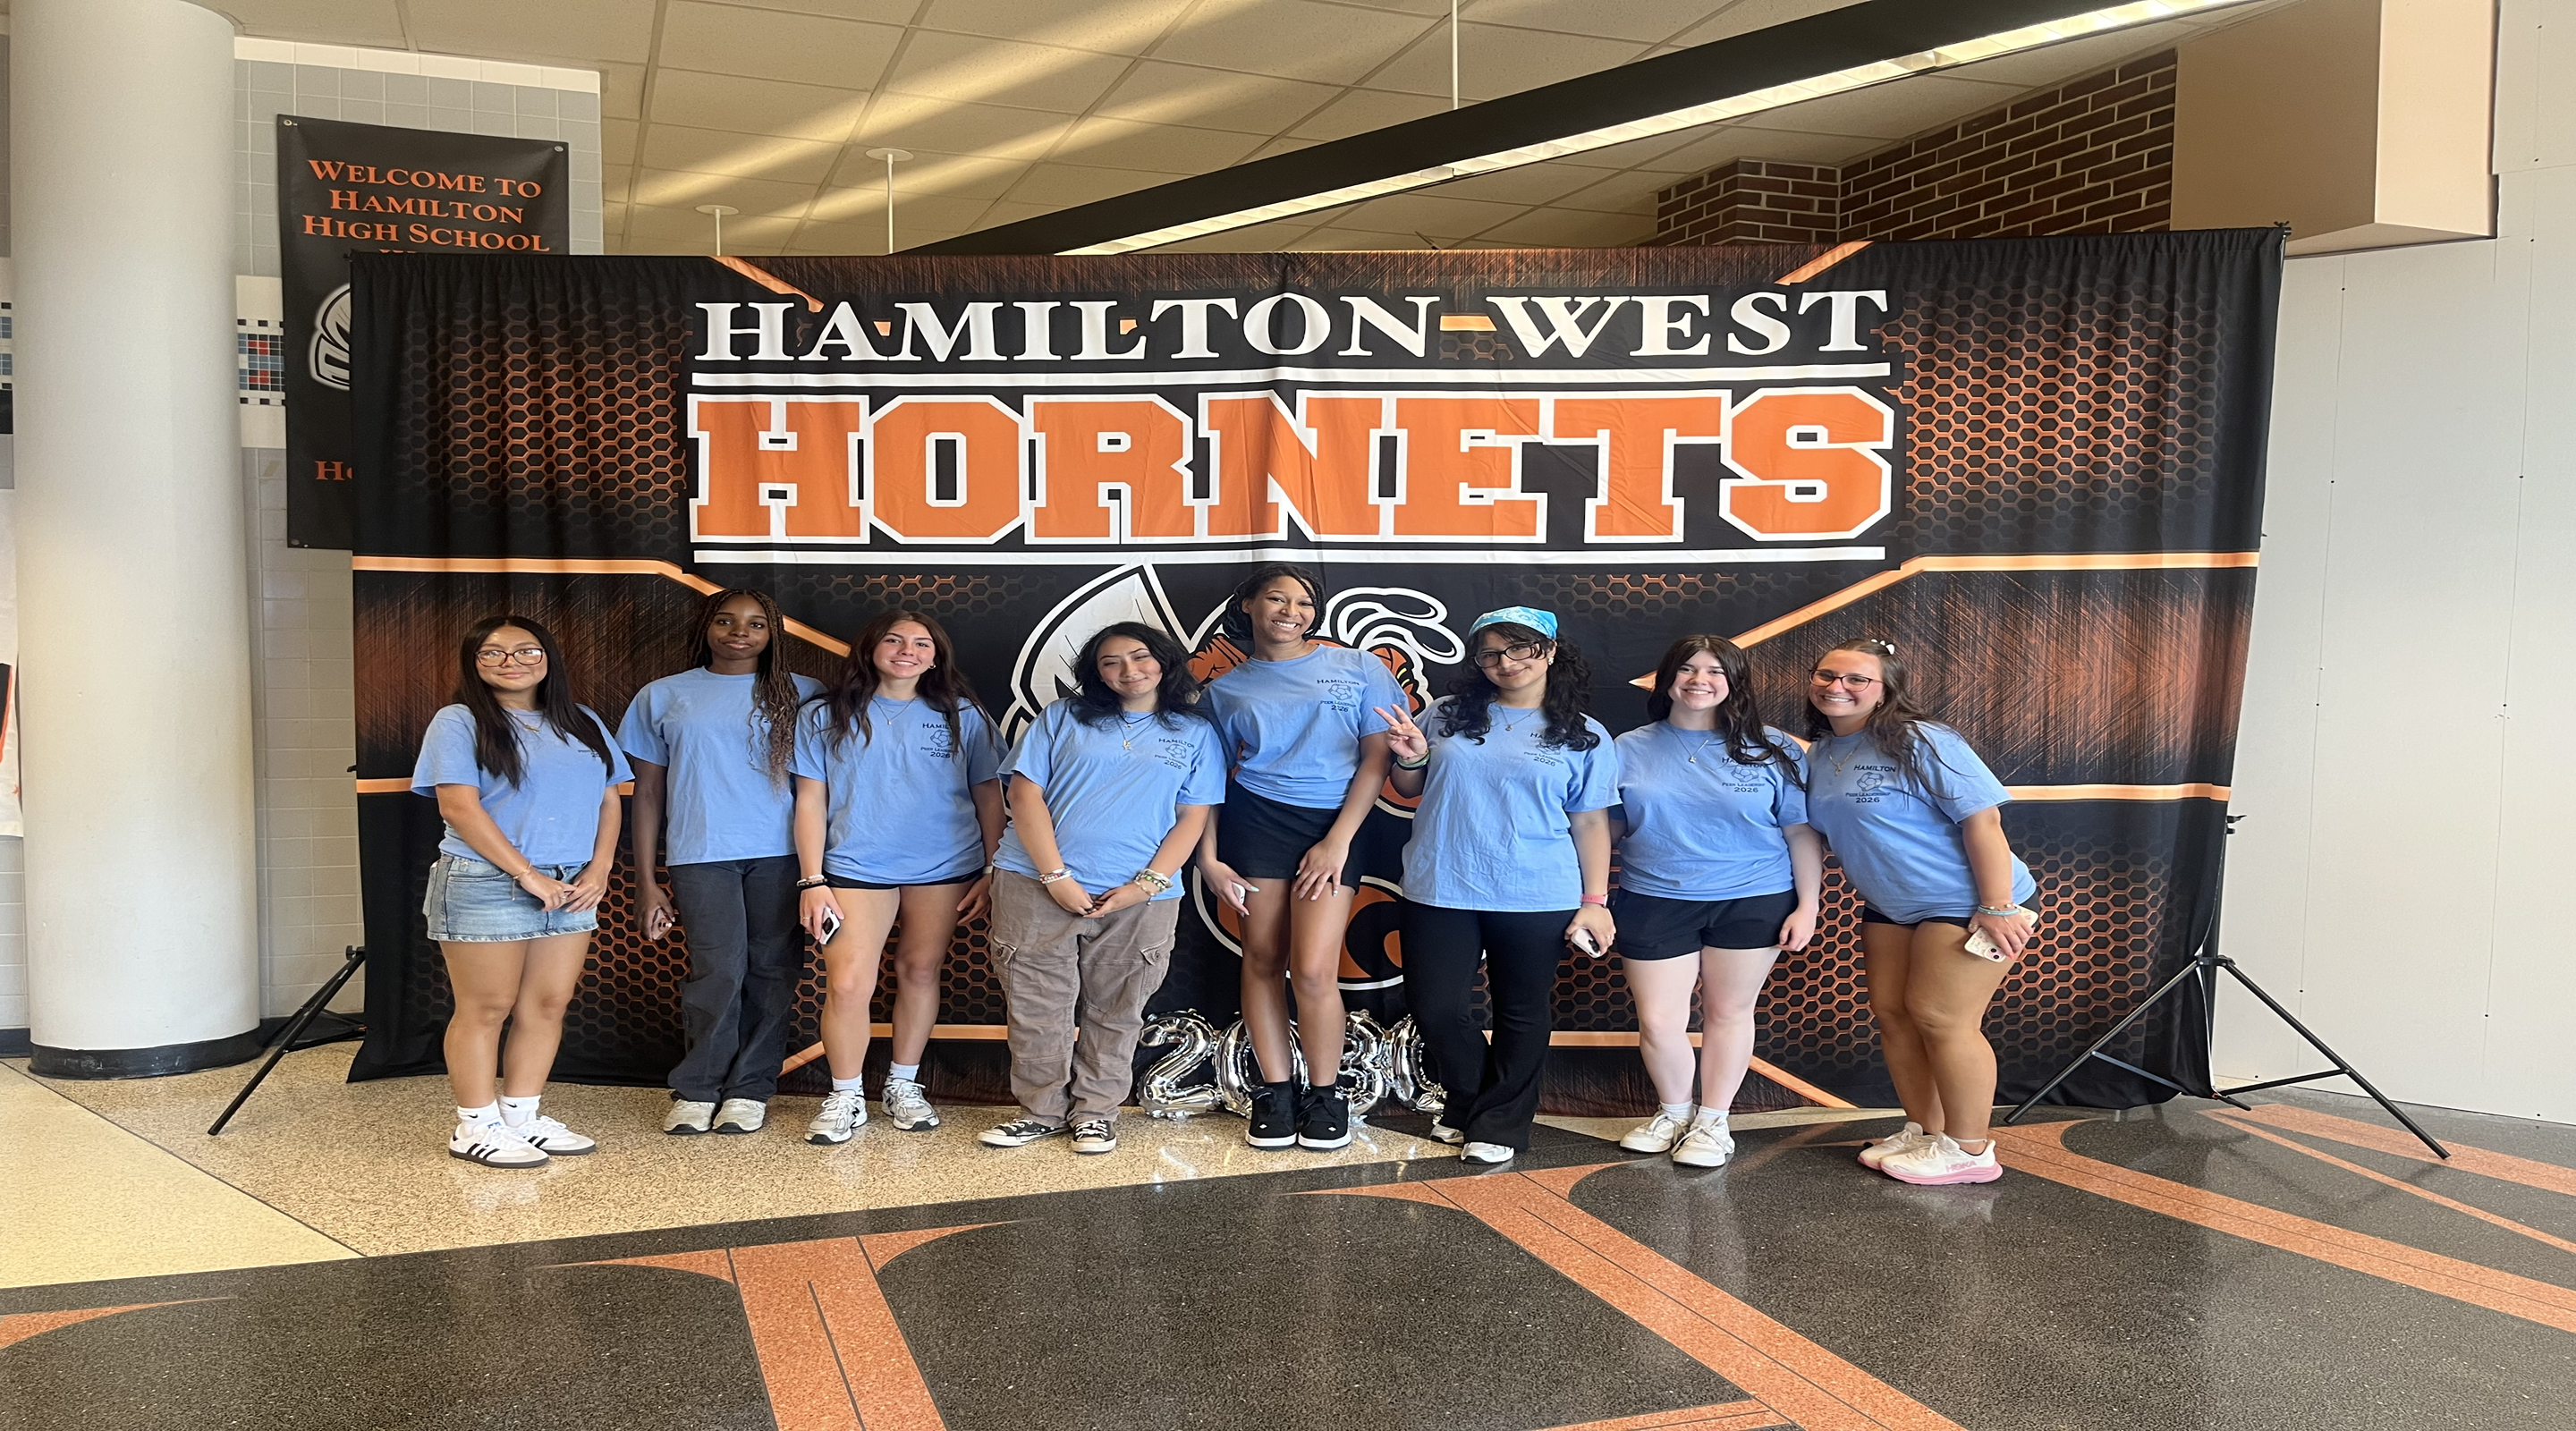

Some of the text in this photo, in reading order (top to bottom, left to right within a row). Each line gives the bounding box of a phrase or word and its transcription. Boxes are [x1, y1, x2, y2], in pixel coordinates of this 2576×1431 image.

[308, 159, 542, 199] WELCOME TO
[328, 189, 524, 224] HAMILTON
[302, 215, 551, 252] HIGH SCHOOL
[694, 289, 1889, 362] HAMILTON WEST
[687, 385, 1894, 545] HORNETS
[930, 751, 951, 759] 2026
[1164, 759, 1182, 770] 2026
[1533, 756, 1556, 767] 2026
[1853, 765, 1897, 773] HAMILTON
[1945, 1160, 1977, 1173] HOKA
